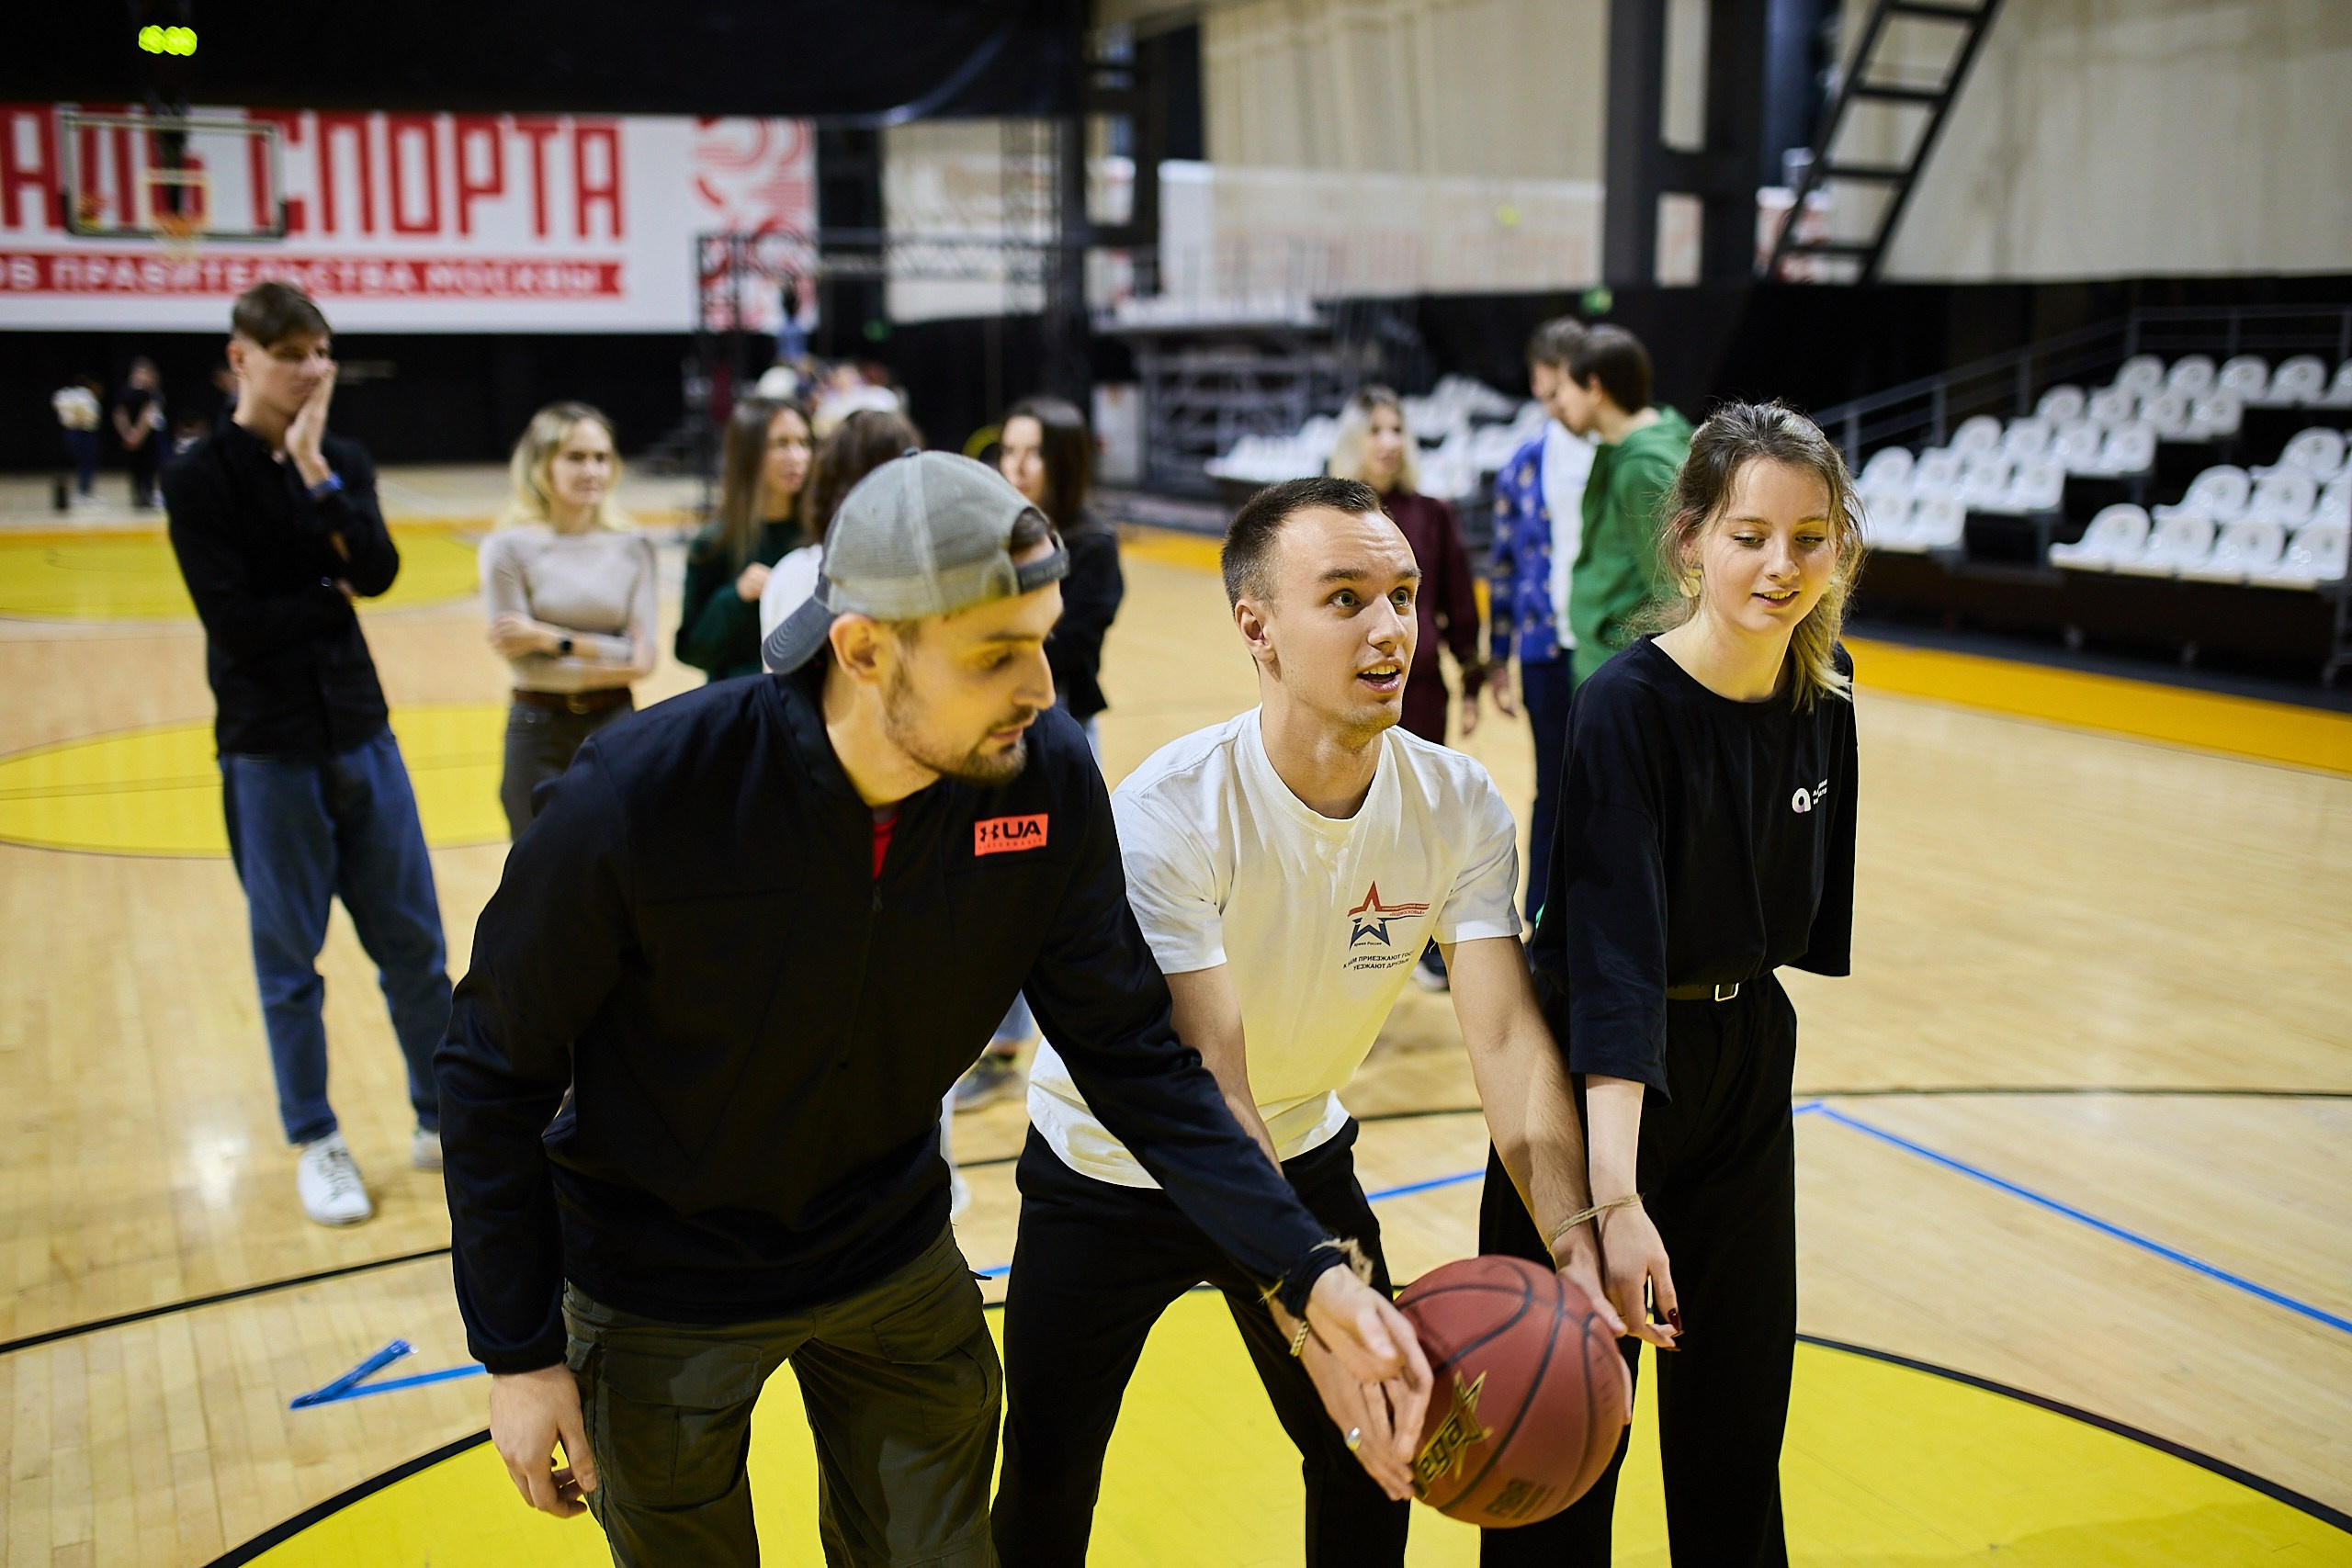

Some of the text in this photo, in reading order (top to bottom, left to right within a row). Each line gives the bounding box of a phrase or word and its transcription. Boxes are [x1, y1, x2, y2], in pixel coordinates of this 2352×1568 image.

[246, 107, 622, 238] СПОРТА
[1002, 820, 1041, 839] UA
[1358, 953, 1401, 962] ПРИЕЗЖАЮТ
[1352, 963, 1386, 972] УЕЗЖАЮТ
